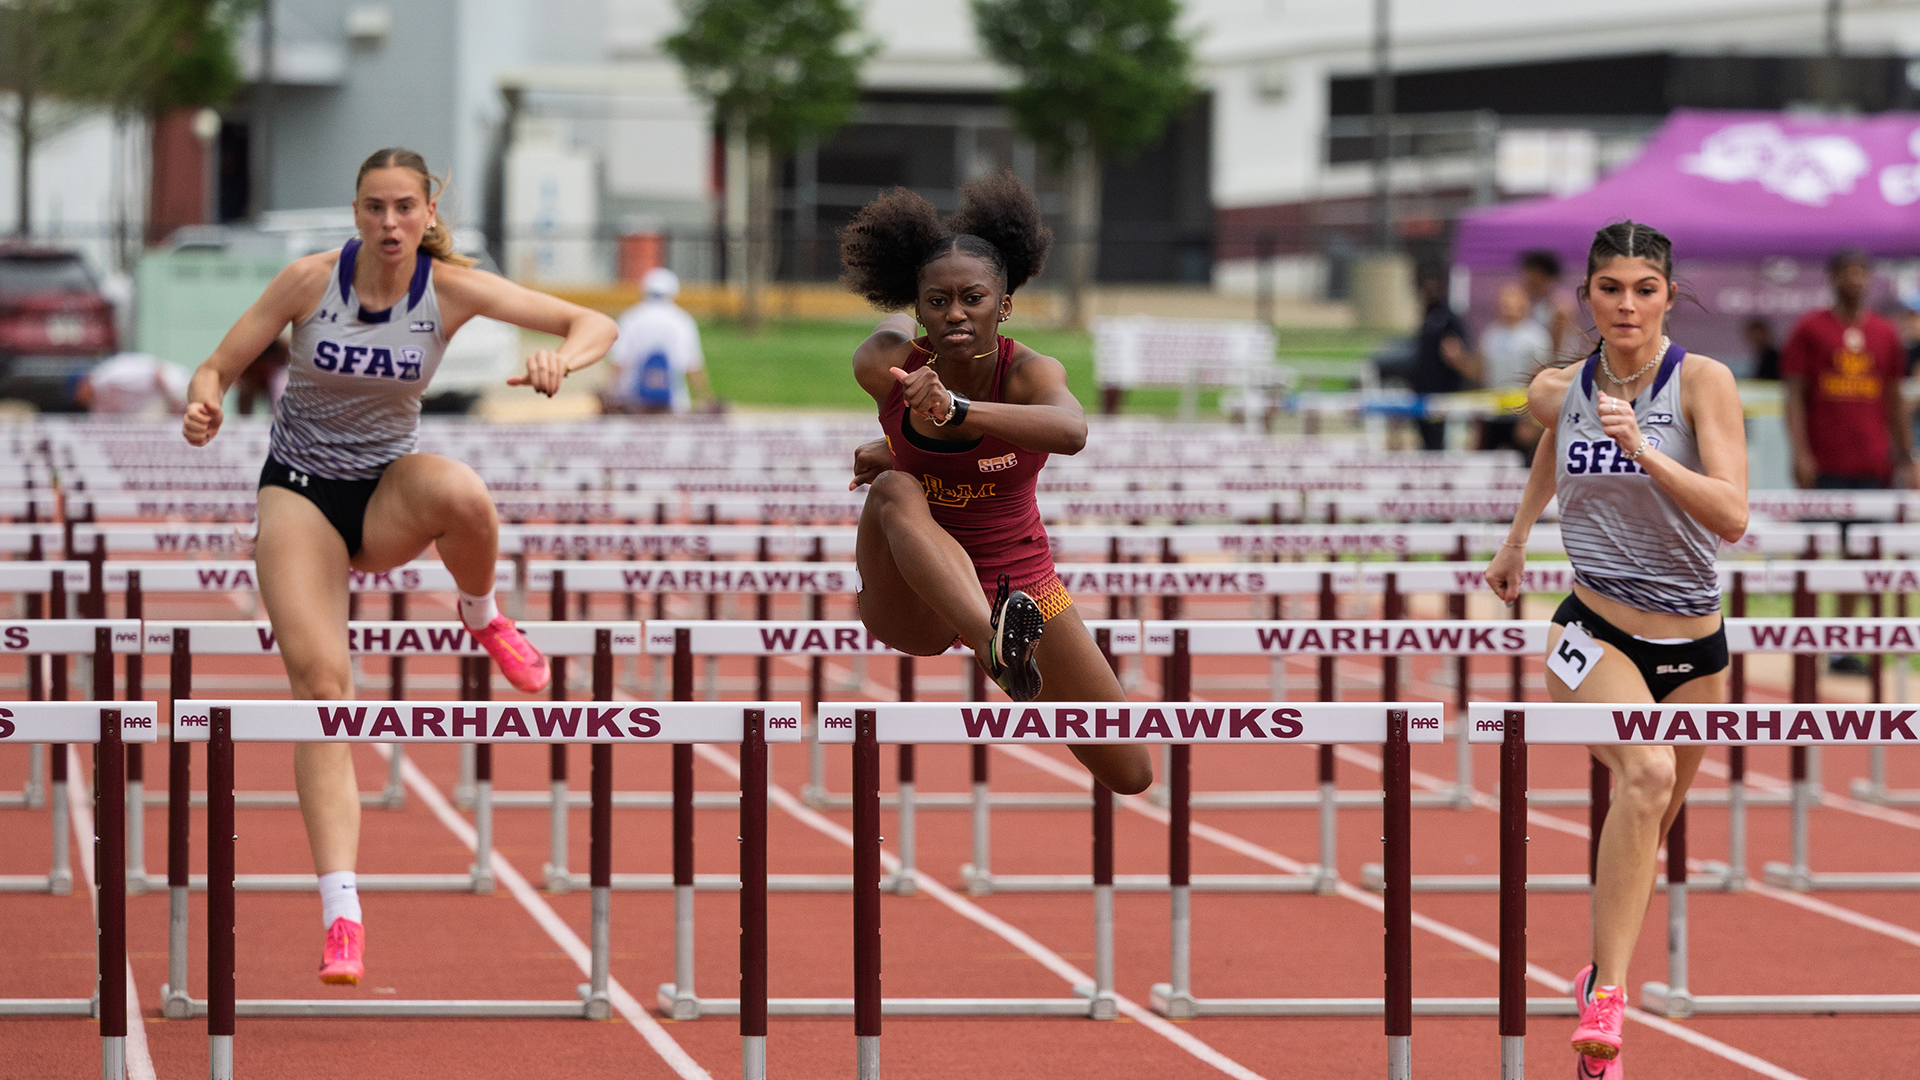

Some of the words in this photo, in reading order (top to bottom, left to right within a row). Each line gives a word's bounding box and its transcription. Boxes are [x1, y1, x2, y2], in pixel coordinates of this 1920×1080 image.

[1646, 414, 1672, 424] SLC
[978, 453, 1017, 472] SBC
[622, 570, 843, 591] WARHAWKS
[1257, 627, 1527, 651] WARHAWKS
[1750, 625, 1920, 648] WARHA
[1558, 639, 1587, 674] 5
[1656, 663, 1695, 674] SLC
[317, 706, 661, 738] WARHAWKS
[960, 707, 1304, 739] WARHAWKS
[1611, 710, 1919, 741] WARHAWK
